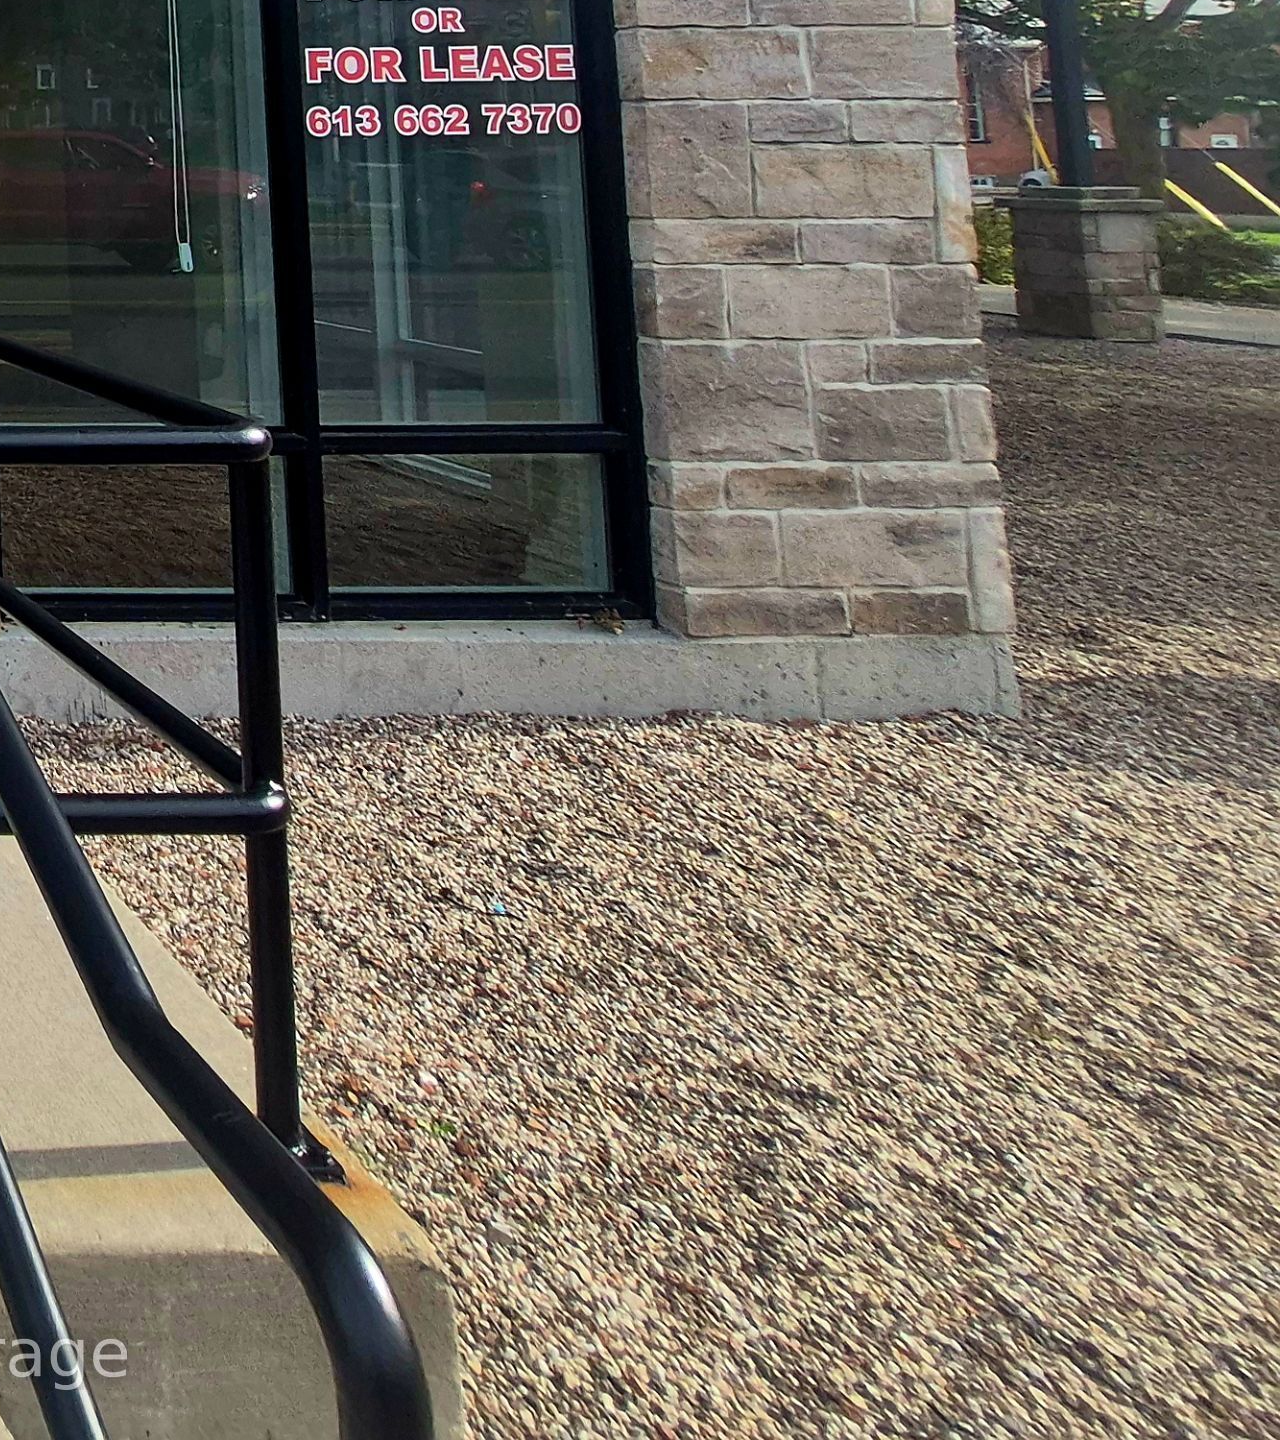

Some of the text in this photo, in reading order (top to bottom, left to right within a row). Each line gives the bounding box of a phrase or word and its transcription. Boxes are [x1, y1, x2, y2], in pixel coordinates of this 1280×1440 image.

[411, 7, 466, 34] OR
[304, 44, 577, 84] FOR LEASE
[306, 102, 582, 137] 613 662 7370
